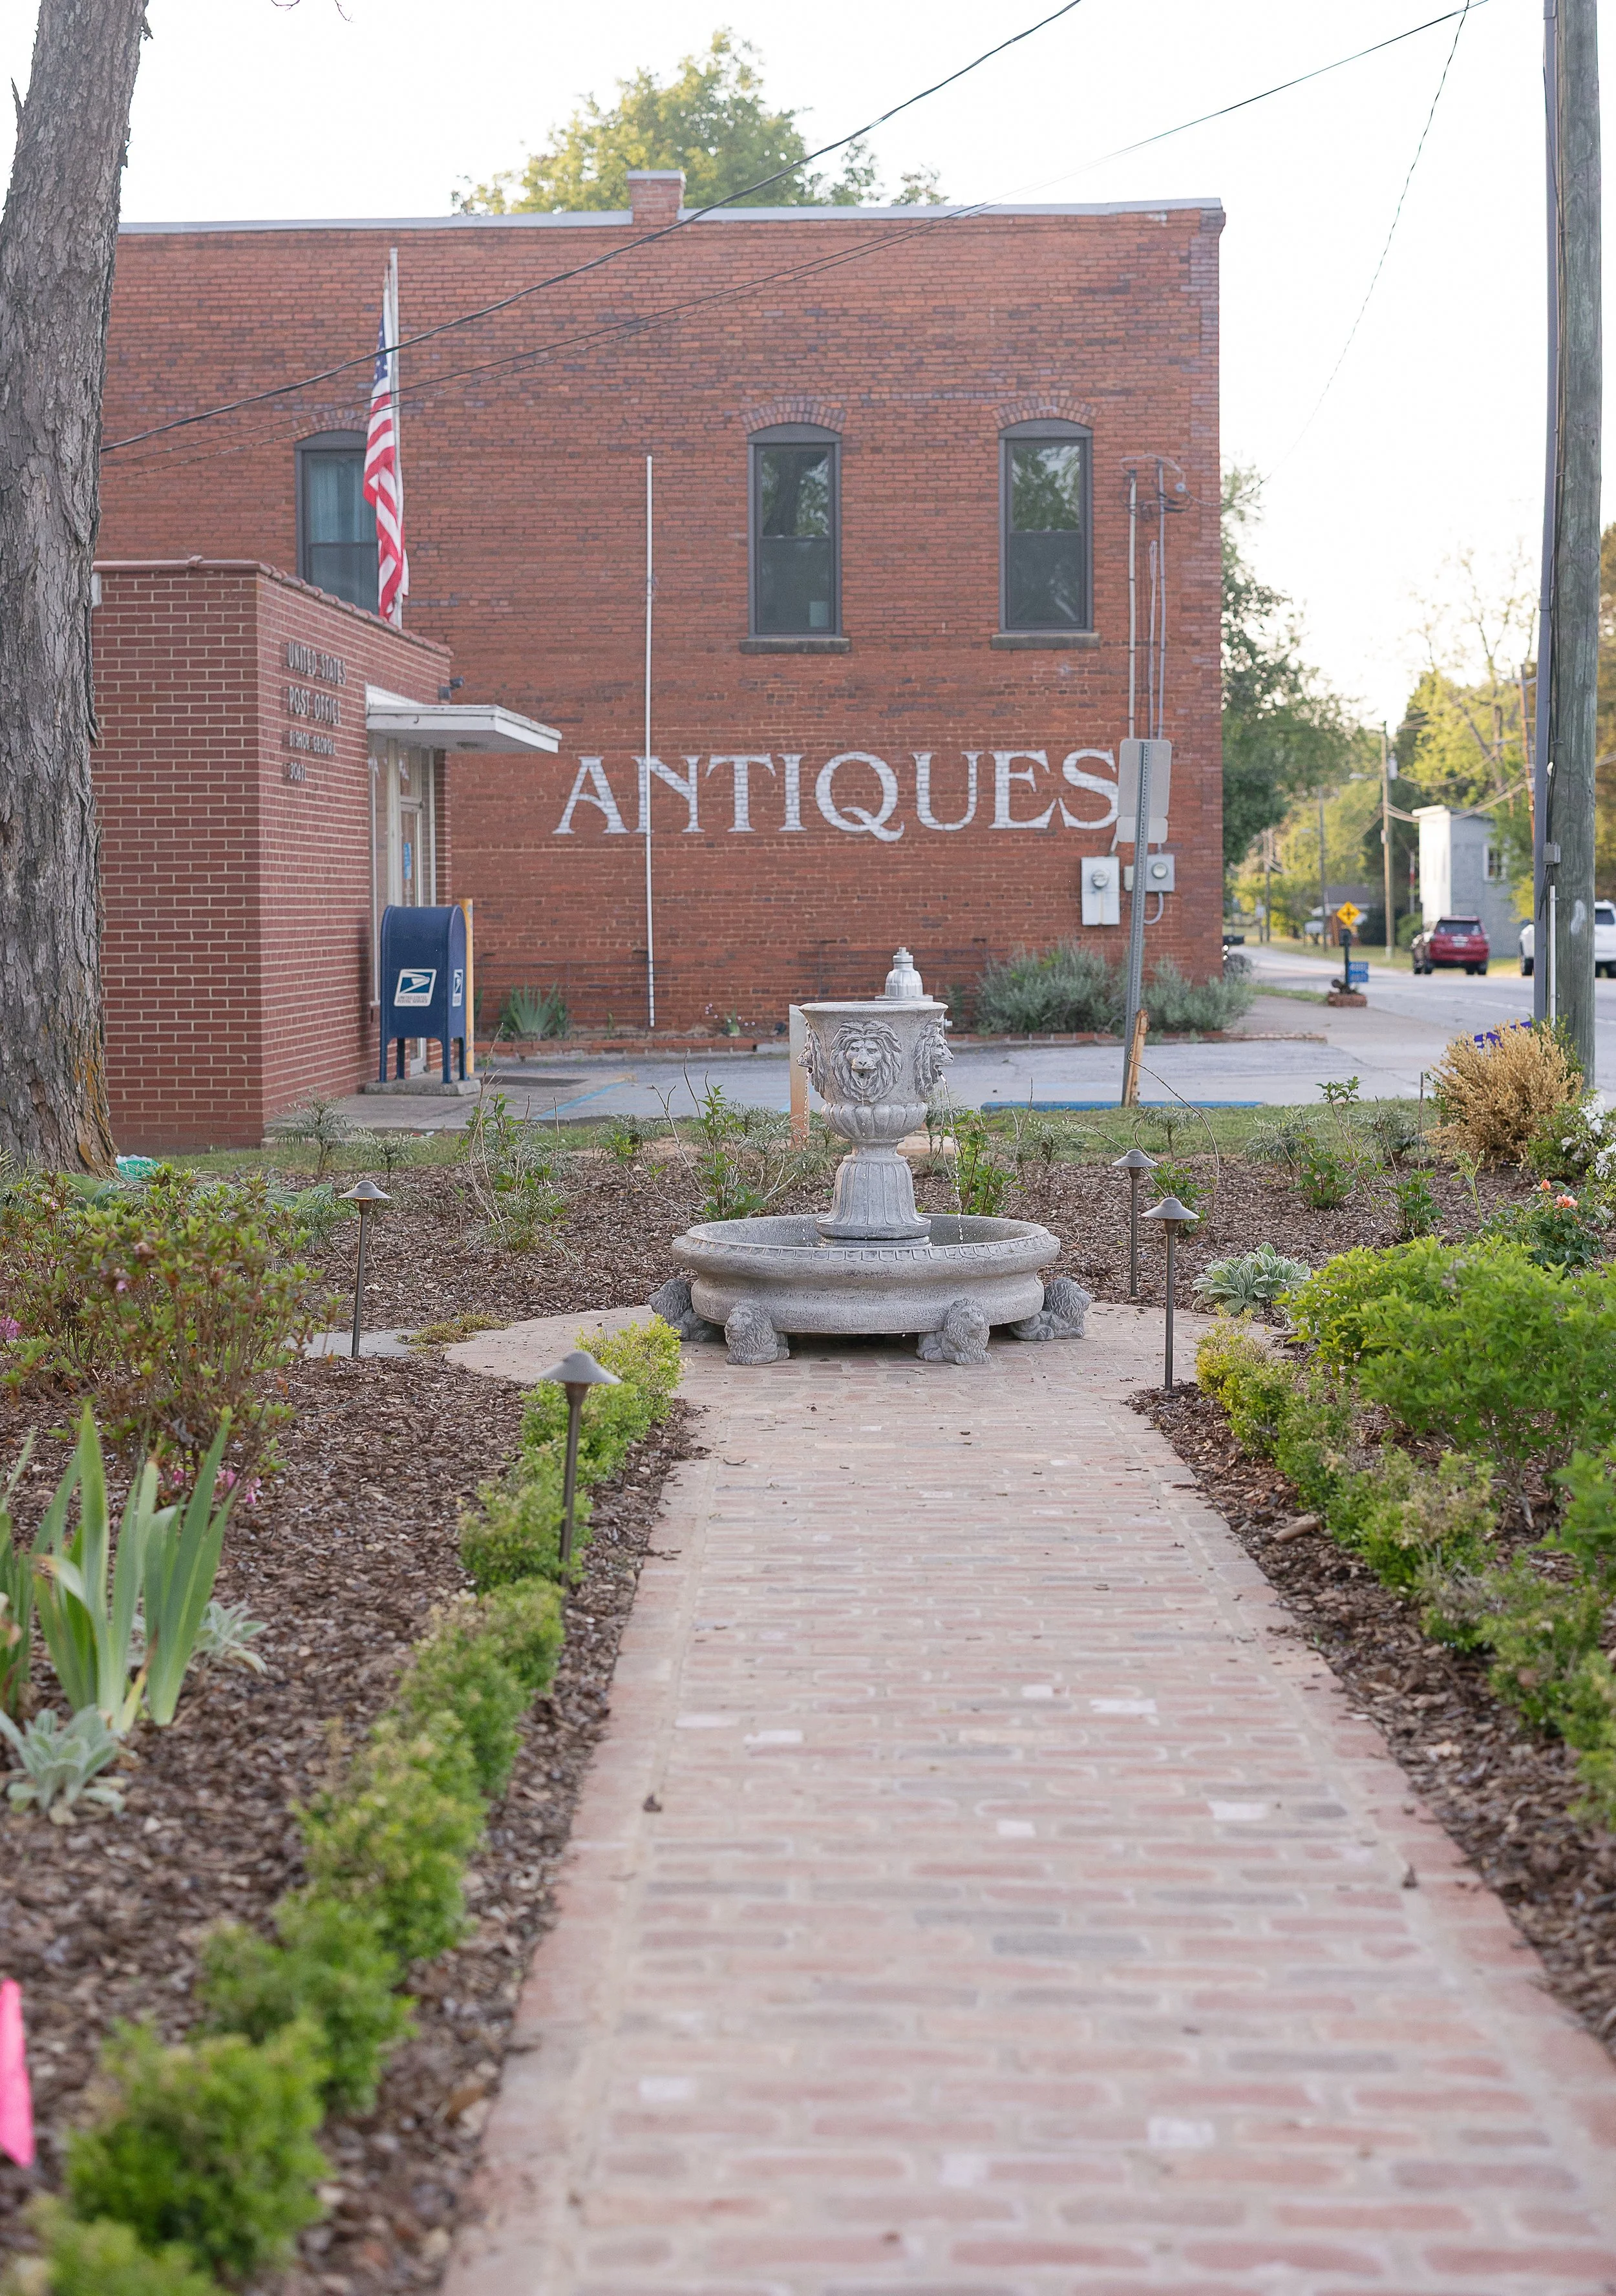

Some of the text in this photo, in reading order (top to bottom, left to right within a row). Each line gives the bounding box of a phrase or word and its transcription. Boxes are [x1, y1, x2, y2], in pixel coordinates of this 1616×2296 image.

[288, 641, 346, 685] UNITED STATES
[288, 686, 341, 724] POST OFFICE
[552, 748, 1120, 841] ANTIQUES
